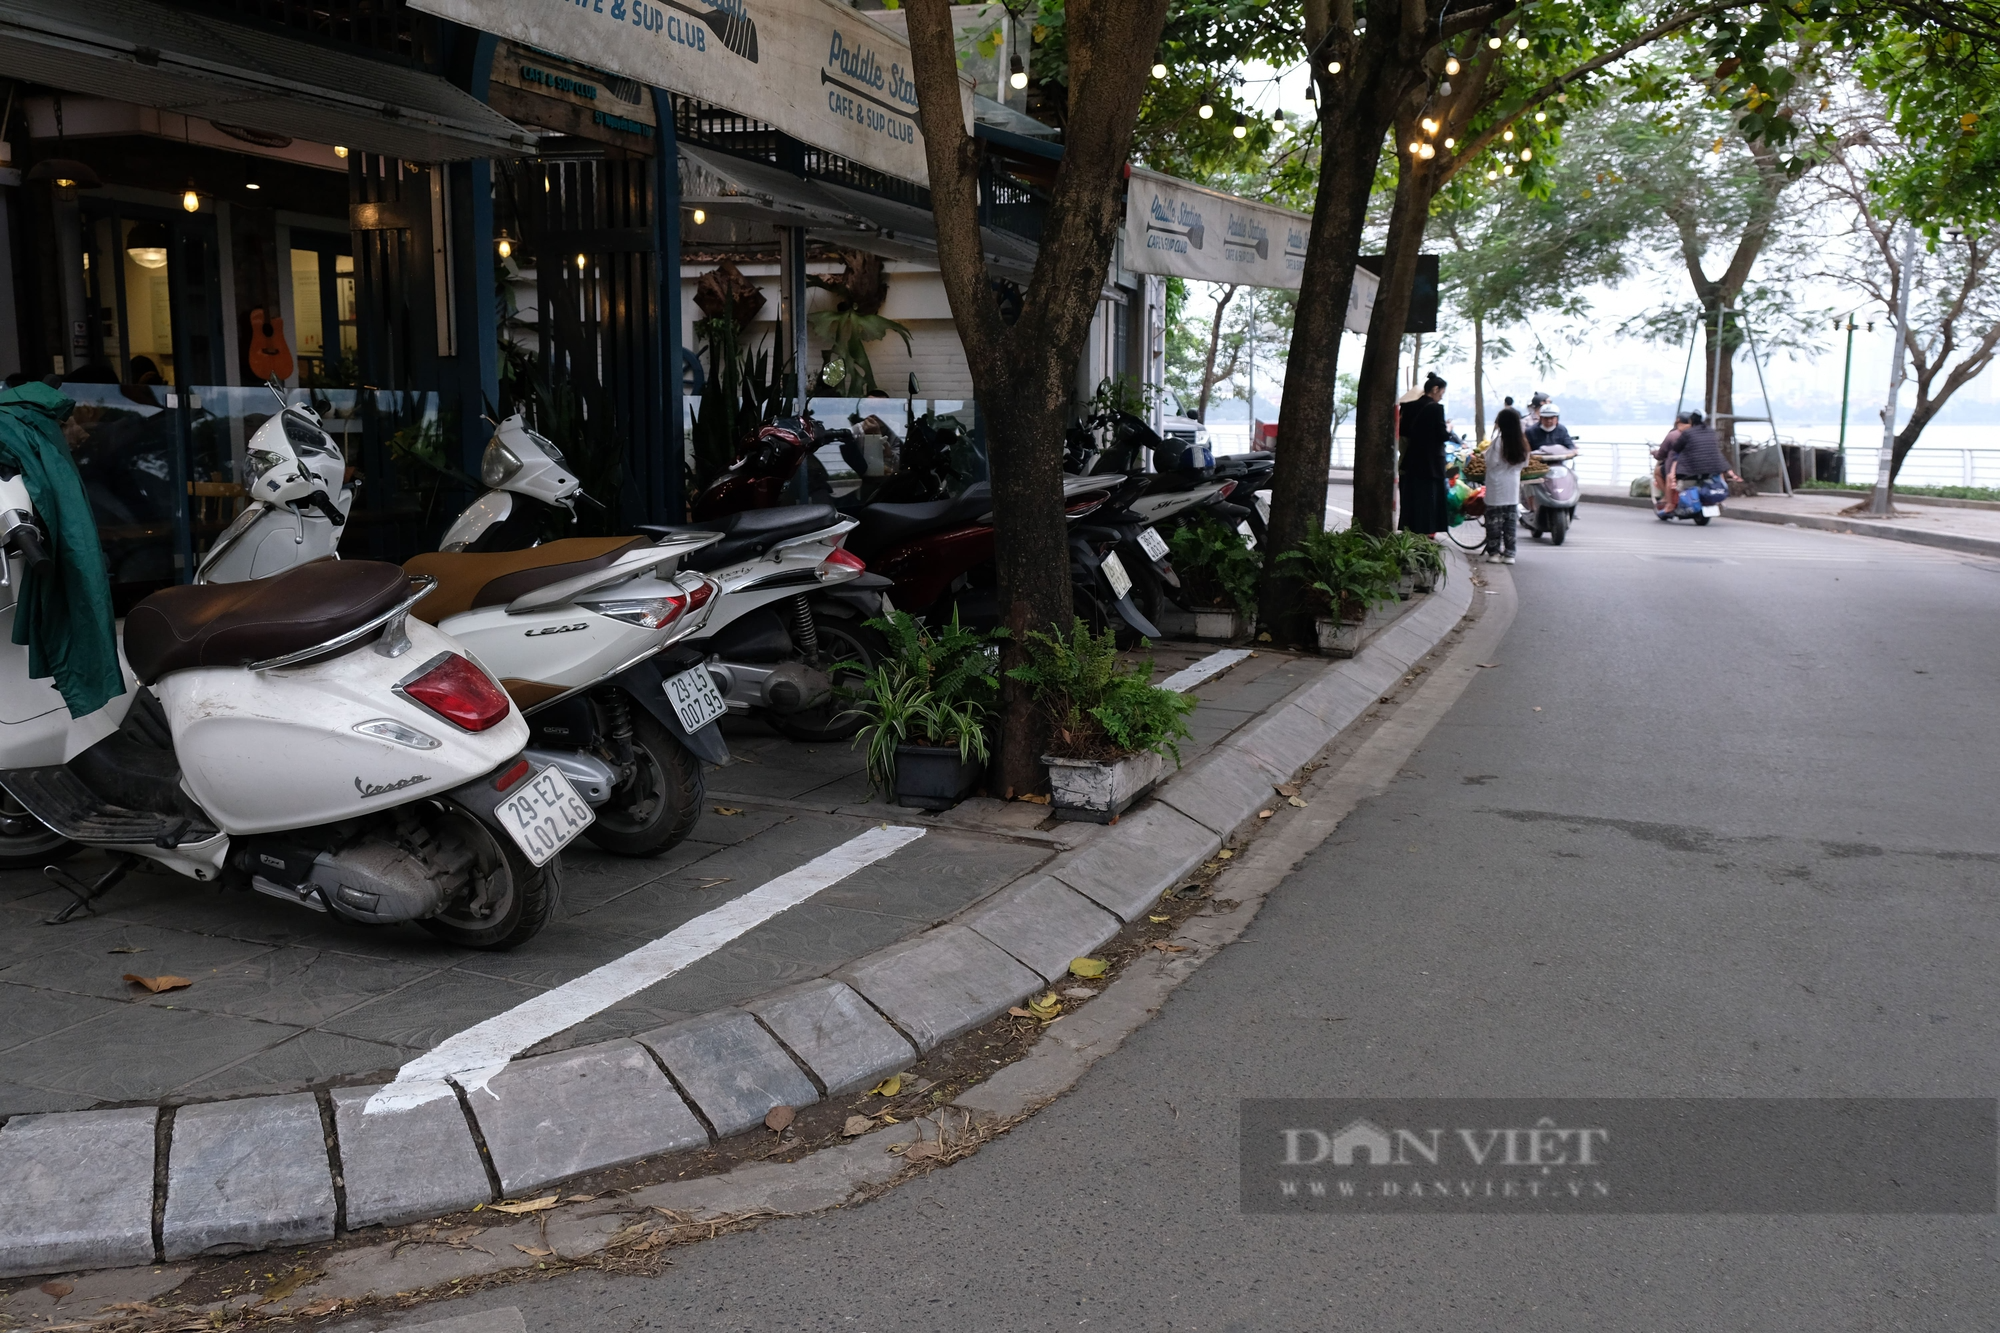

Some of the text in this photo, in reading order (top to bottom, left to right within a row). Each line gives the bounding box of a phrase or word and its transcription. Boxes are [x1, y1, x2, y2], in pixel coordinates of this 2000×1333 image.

[611, 0, 626, 21] &
[632, 0, 663, 34] SUP
[667, 15, 706, 53] CLUB
[522, 65, 597, 100] CAFE & SUP CLUB
[829, 29, 919, 108] Paddle Sta
[829, 91, 914, 144] CAFE & SUP CLUB
[1151, 194, 1176, 223] Paddle
[1147, 234, 1161, 249] CAFE
[1174, 240, 1188, 254] CLUB
[524, 622, 590, 637] LEAD
[671, 667, 708, 704] 29-L5
[680, 688, 723, 729] 007.95
[354, 776, 432, 799] Vespa
[507, 774, 565, 830] 29-E2
[523, 796, 588, 858] 402.46
